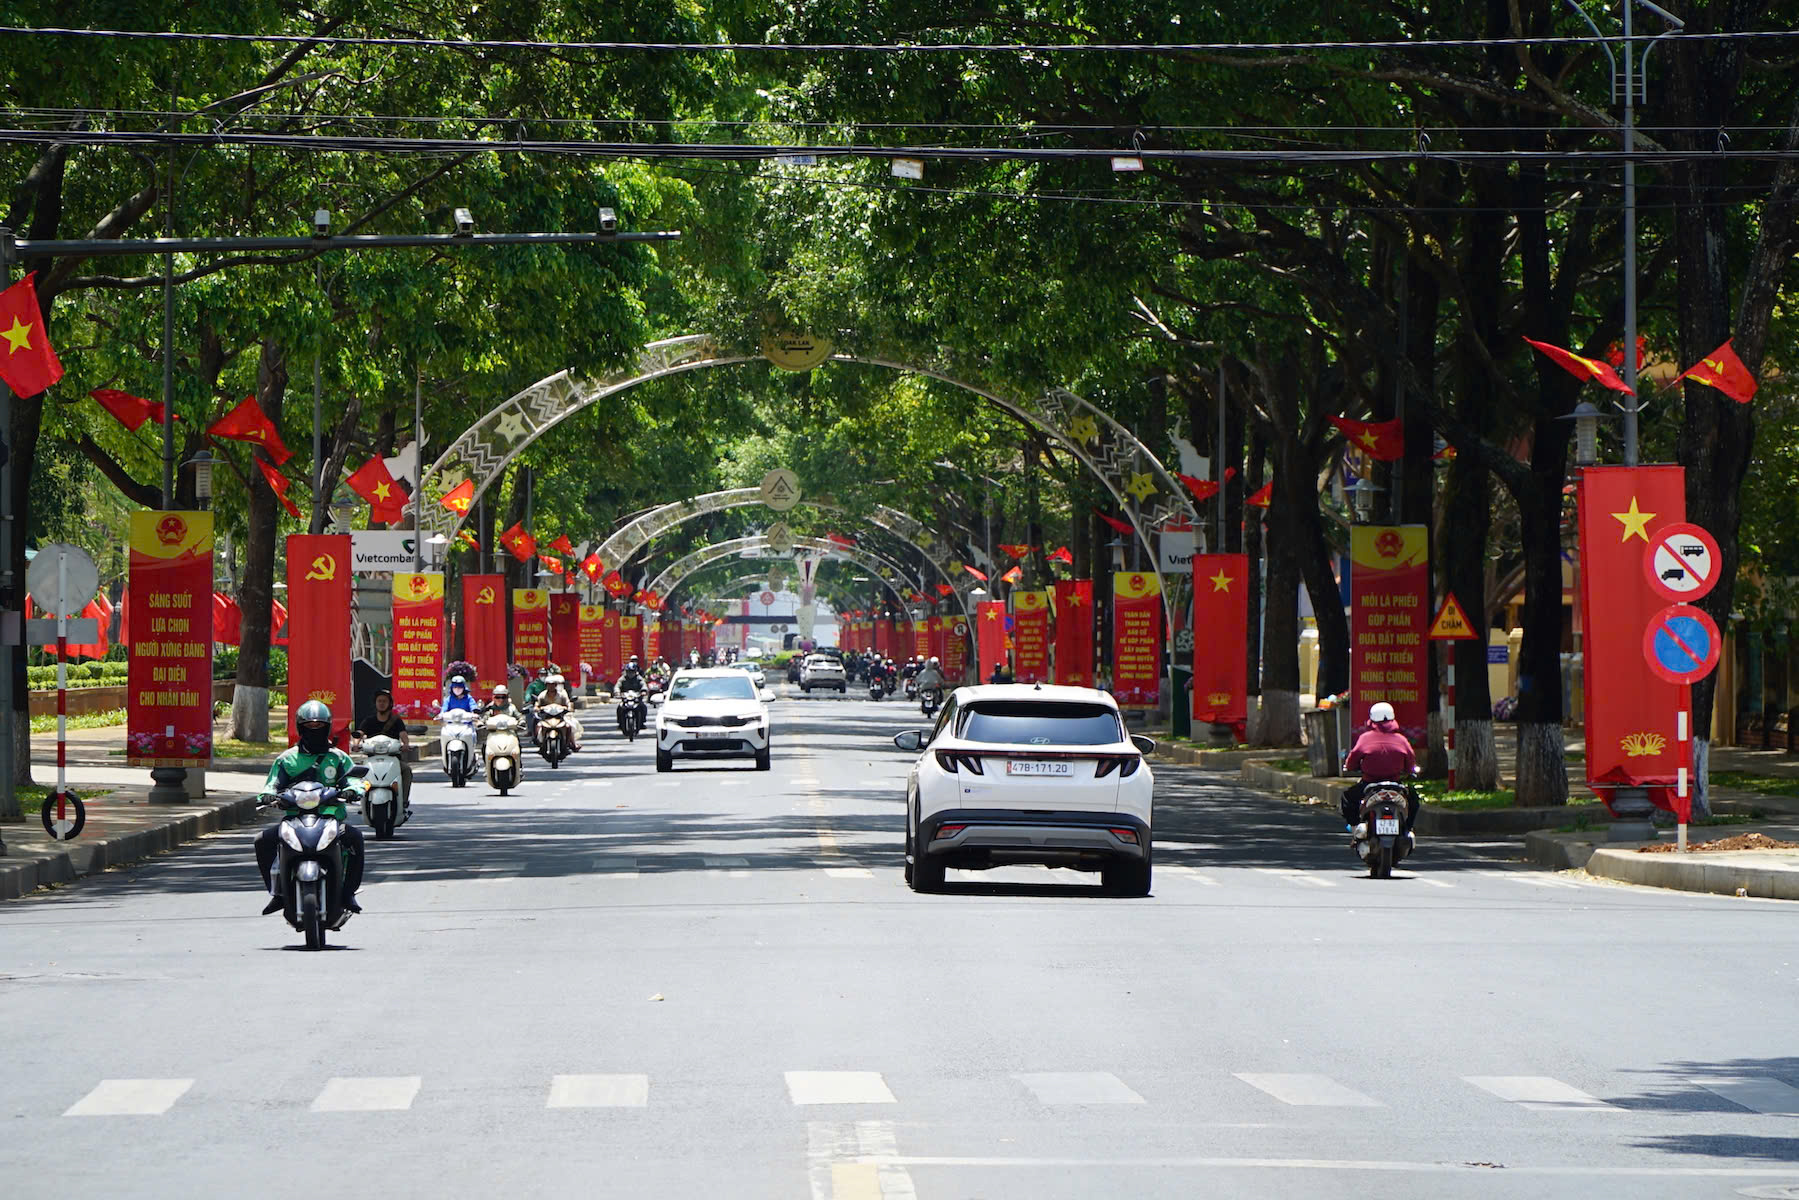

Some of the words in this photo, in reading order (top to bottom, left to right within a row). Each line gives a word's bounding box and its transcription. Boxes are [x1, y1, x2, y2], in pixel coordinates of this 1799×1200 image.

[356, 553, 424, 563] Vietcomba
[149, 591, 171, 608] SÁNG
[172, 589, 192, 608] SUỐT
[152, 617, 166, 635] LỰA
[168, 618, 190, 636] CHỌN
[135, 640, 159, 656] NGƯỜI
[161, 640, 182, 657] XỨNG
[184, 641, 205, 657] ĐÁNG
[153, 667, 166, 684] ĐẠI
[140, 691, 155, 706] CHO
[157, 688, 178, 706] NHÂN
[181, 689, 200, 706] DÂN!
[1013, 763, 1068, 773] 47B-171.20
